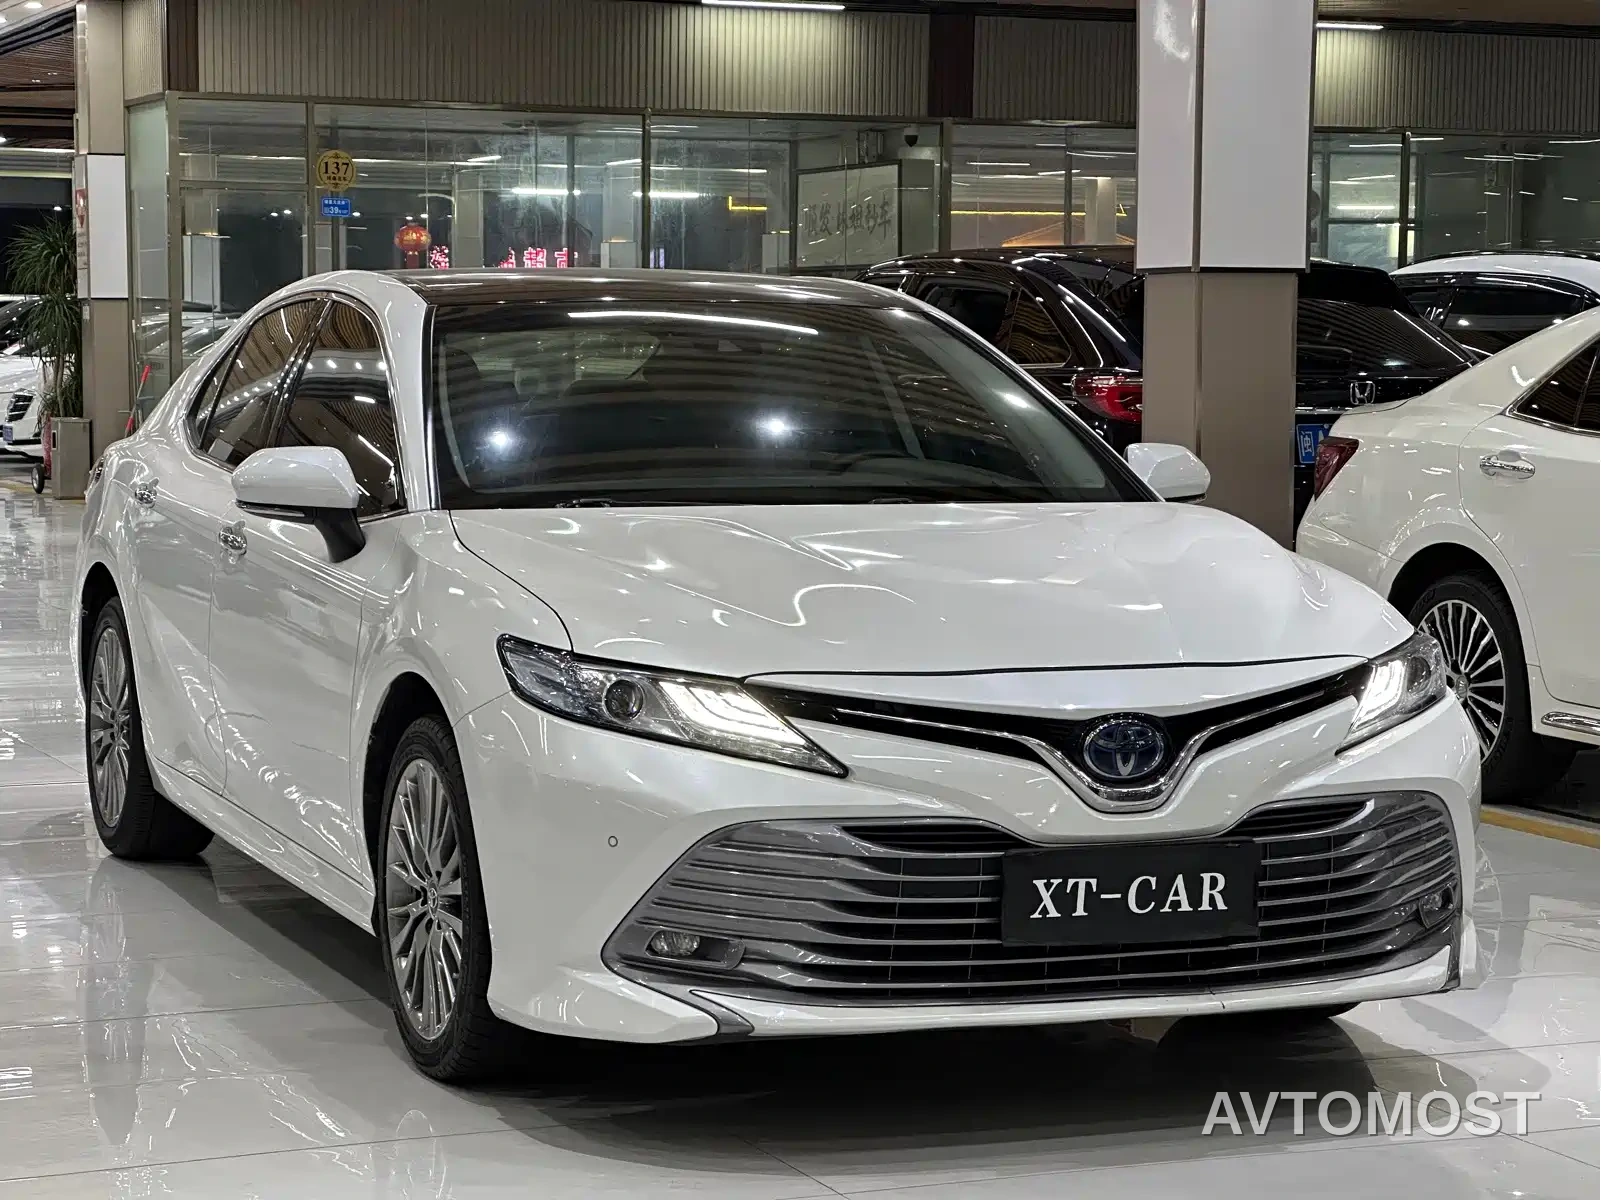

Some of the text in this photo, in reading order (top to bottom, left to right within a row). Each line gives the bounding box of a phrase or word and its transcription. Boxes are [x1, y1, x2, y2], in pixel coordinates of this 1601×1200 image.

[323, 161, 349, 175] 137
[1300, 430, 1325, 457] 闽
[1030, 872, 1228, 919] XT-CAR
